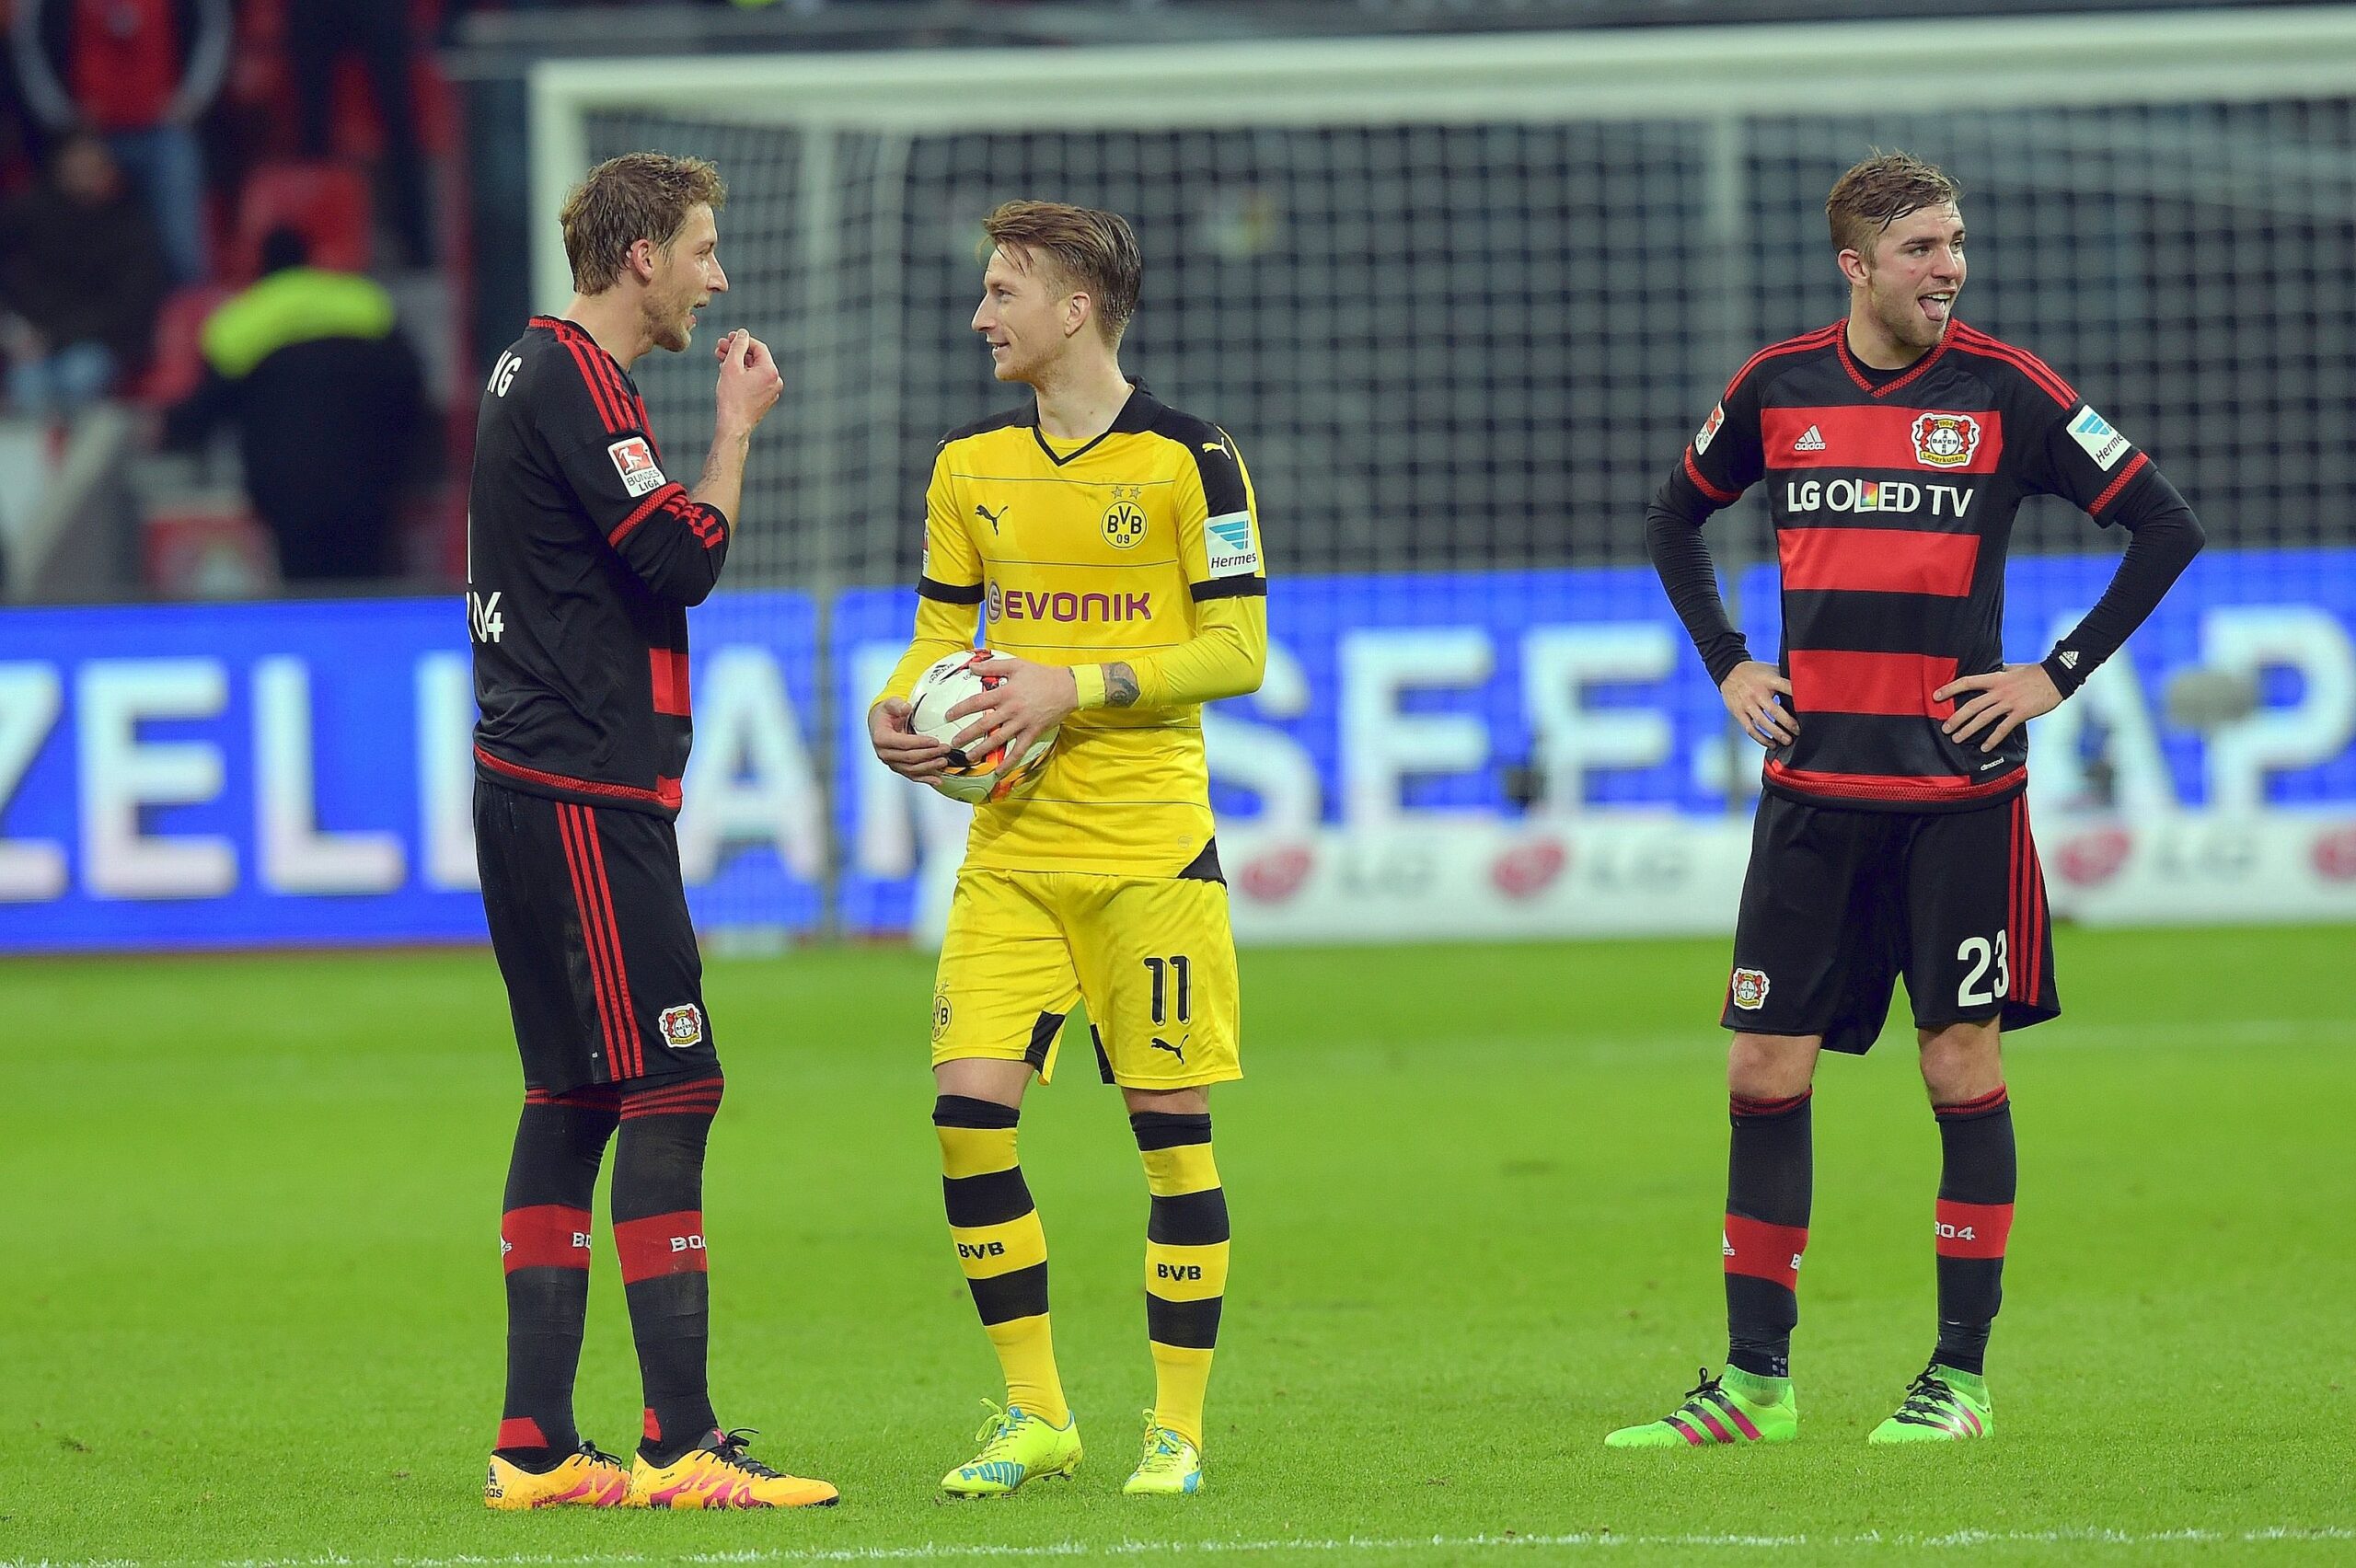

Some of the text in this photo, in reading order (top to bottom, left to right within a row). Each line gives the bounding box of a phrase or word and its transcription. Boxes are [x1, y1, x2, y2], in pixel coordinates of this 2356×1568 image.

[1794, 442, 1826, 451] adidas
[627, 469, 661, 487] BUNDES
[639, 478, 660, 491] LIGA
[1787, 478, 1974, 518] LG OLED TV
[1106, 505, 1143, 535] BVB
[1116, 534, 1130, 544] 09
[1210, 552, 1256, 569] Hermes
[1005, 590, 1152, 622] EVONIK
[1957, 929, 2010, 1007] 23
[1143, 955, 1191, 1027] 11
[957, 1242, 1005, 1259] BVB
[1157, 1263, 1202, 1281] BVB
